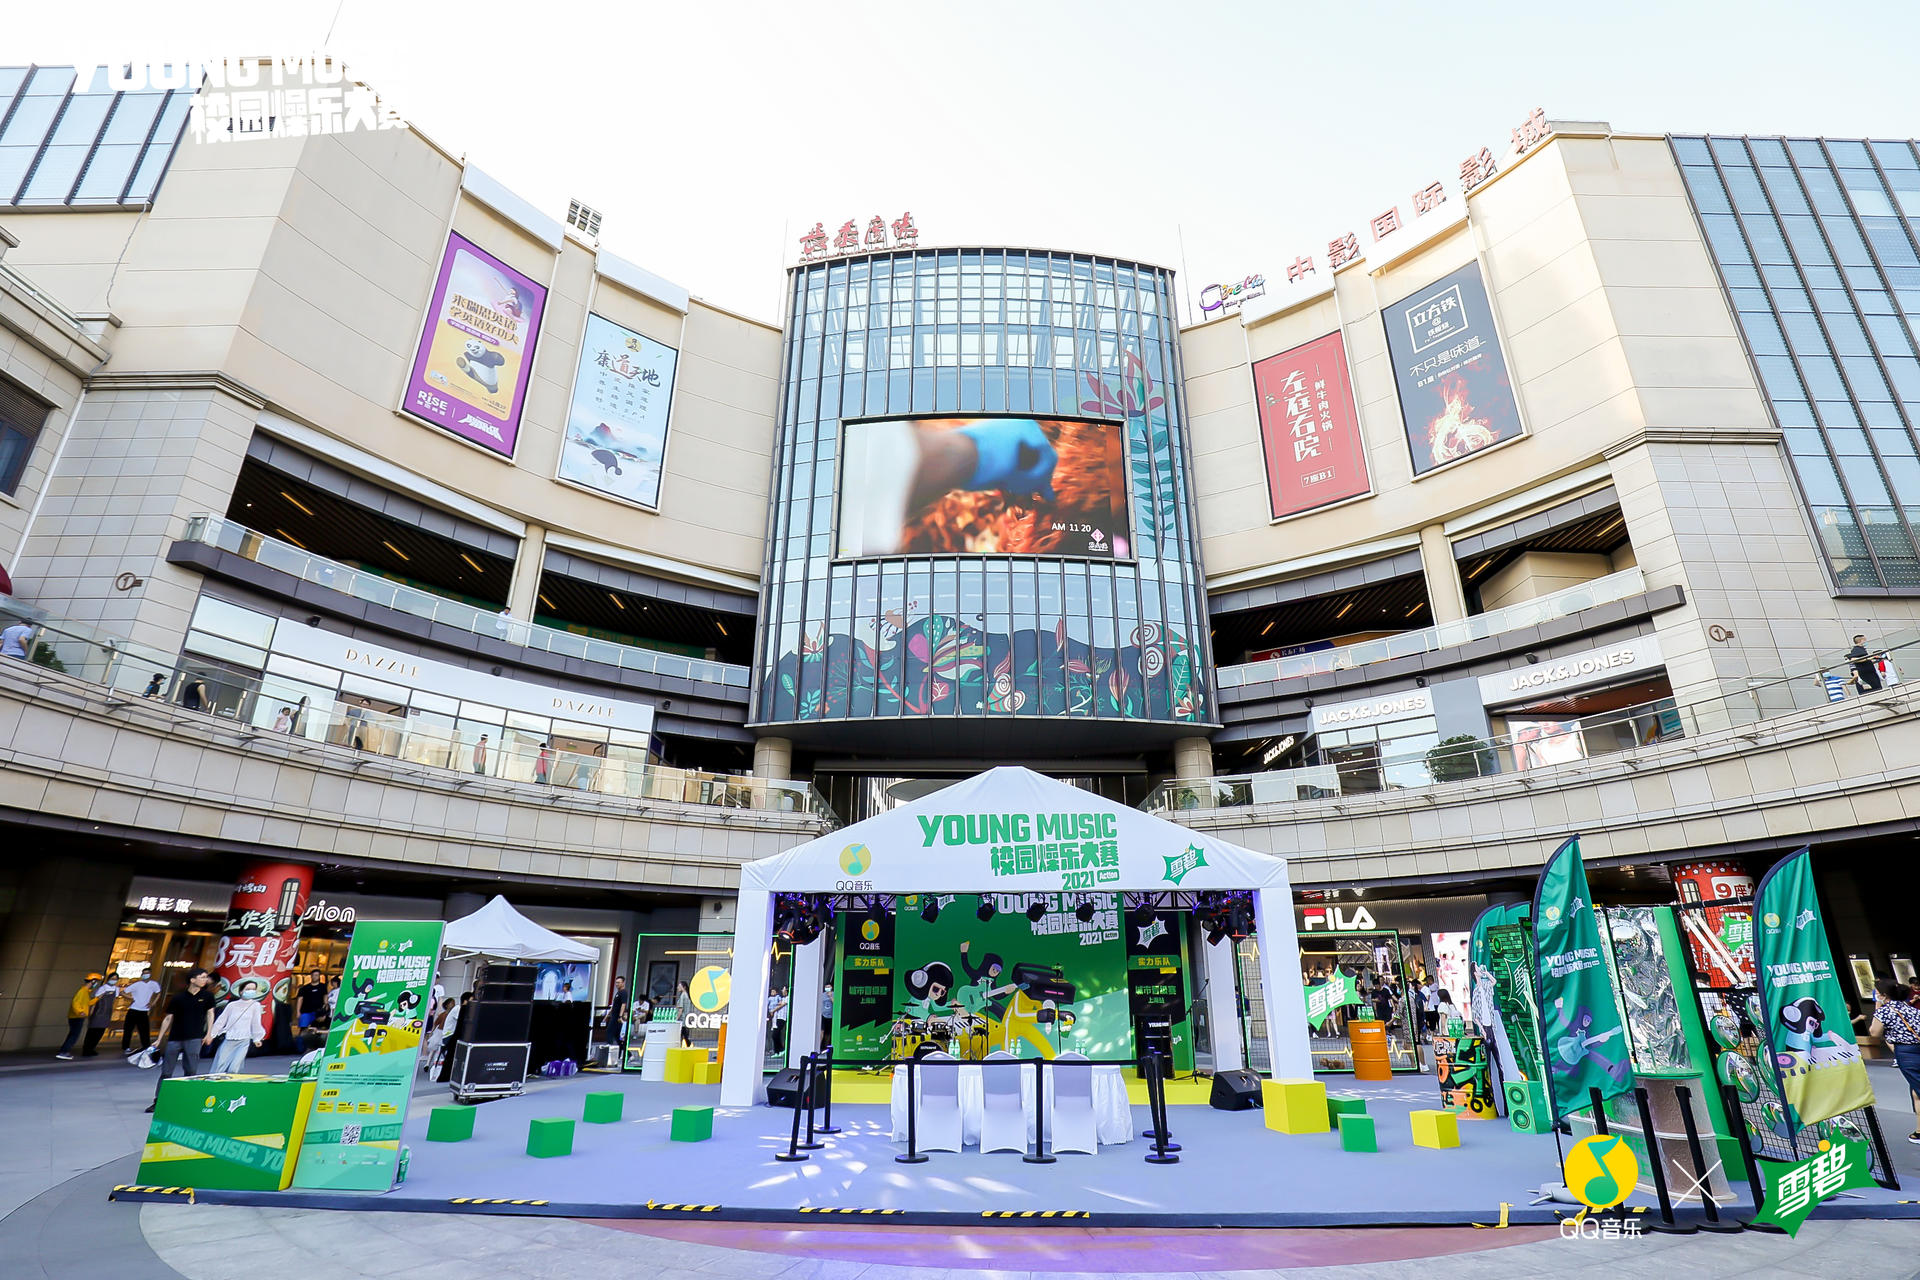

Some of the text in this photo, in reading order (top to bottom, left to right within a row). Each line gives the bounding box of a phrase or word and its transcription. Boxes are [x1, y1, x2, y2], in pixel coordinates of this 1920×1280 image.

[1286, 107, 1551, 282] 中影国际影城
[1412, 296, 1459, 328] 立方铁
[1280, 369, 1323, 463] 左庭右院
[1314, 378, 1334, 432] 鲜牛肉火锅
[1051, 522, 1066, 531] AM
[346, 648, 419, 679] DAZZLE
[1510, 648, 1636, 692] JACK&JONES
[552, 697, 616, 718] DAZZLE
[1319, 696, 1427, 725] JACK&JONES
[1263, 735, 1295, 765] JACK&JONES
[916, 813, 1118, 847] YOUNG MUSIC
[990, 840, 1119, 876] 校园燥乐大赛
[835, 880, 873, 891] QQ音乐
[1061, 869, 1096, 891] 2021
[223, 907, 281, 937] 工作餐
[1303, 905, 1377, 931] FILA
[1079, 931, 1103, 946] 2021
[353, 954, 432, 970] YOUNG MUSIC
[1545, 947, 1599, 968] YOUNG MUSIC
[1766, 960, 1830, 976] YOUNG MUSIC
[1307, 977, 1348, 1018] 雪碧
[163, 1124, 203, 1150] YOUNG
[203, 1135, 258, 1164] MUSIC
